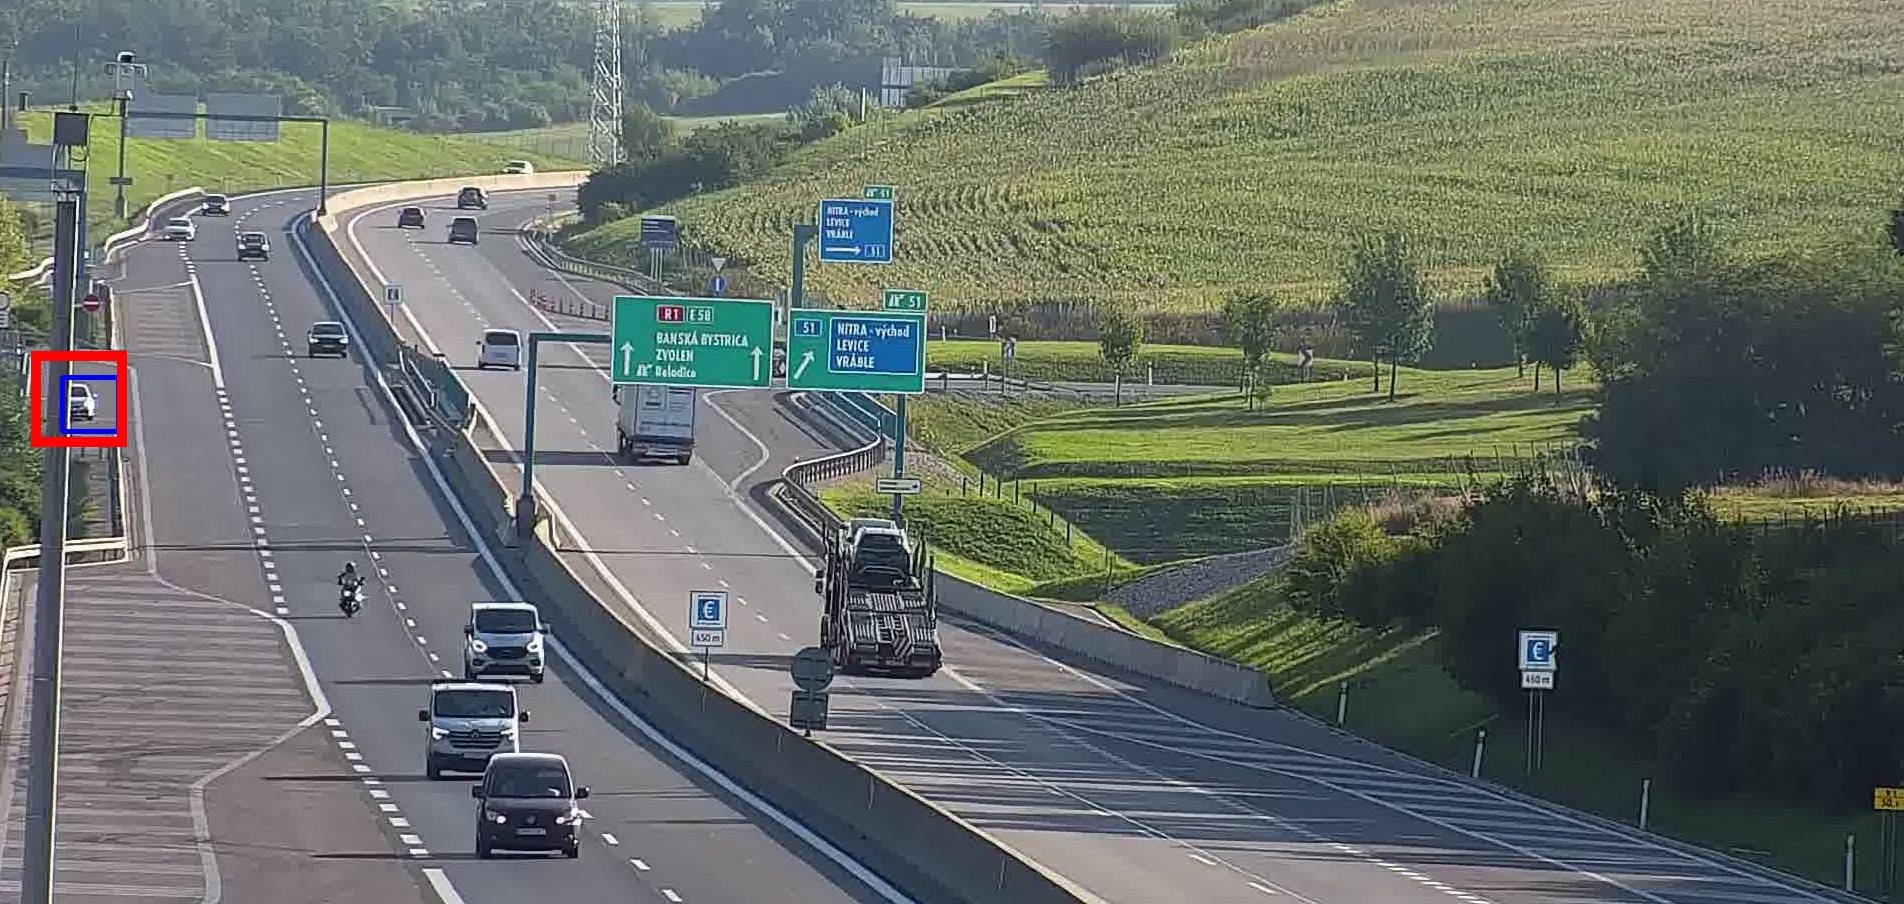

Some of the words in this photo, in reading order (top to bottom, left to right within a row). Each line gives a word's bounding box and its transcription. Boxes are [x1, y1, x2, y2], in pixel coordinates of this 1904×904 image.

[909, 295, 921, 308] 51
[664, 308, 679, 320] R1
[802, 322, 815, 334] 51
[837, 322, 867, 336] NITRA
[875, 323, 910, 339] východ
[656, 330, 699, 346] BANSKÁ
[701, 333, 749, 347] BYSTRICA
[836, 339, 870, 352] LEVICE
[655, 349, 694, 362] ZVOLEN
[836, 353, 875, 369] VRÁBLE
